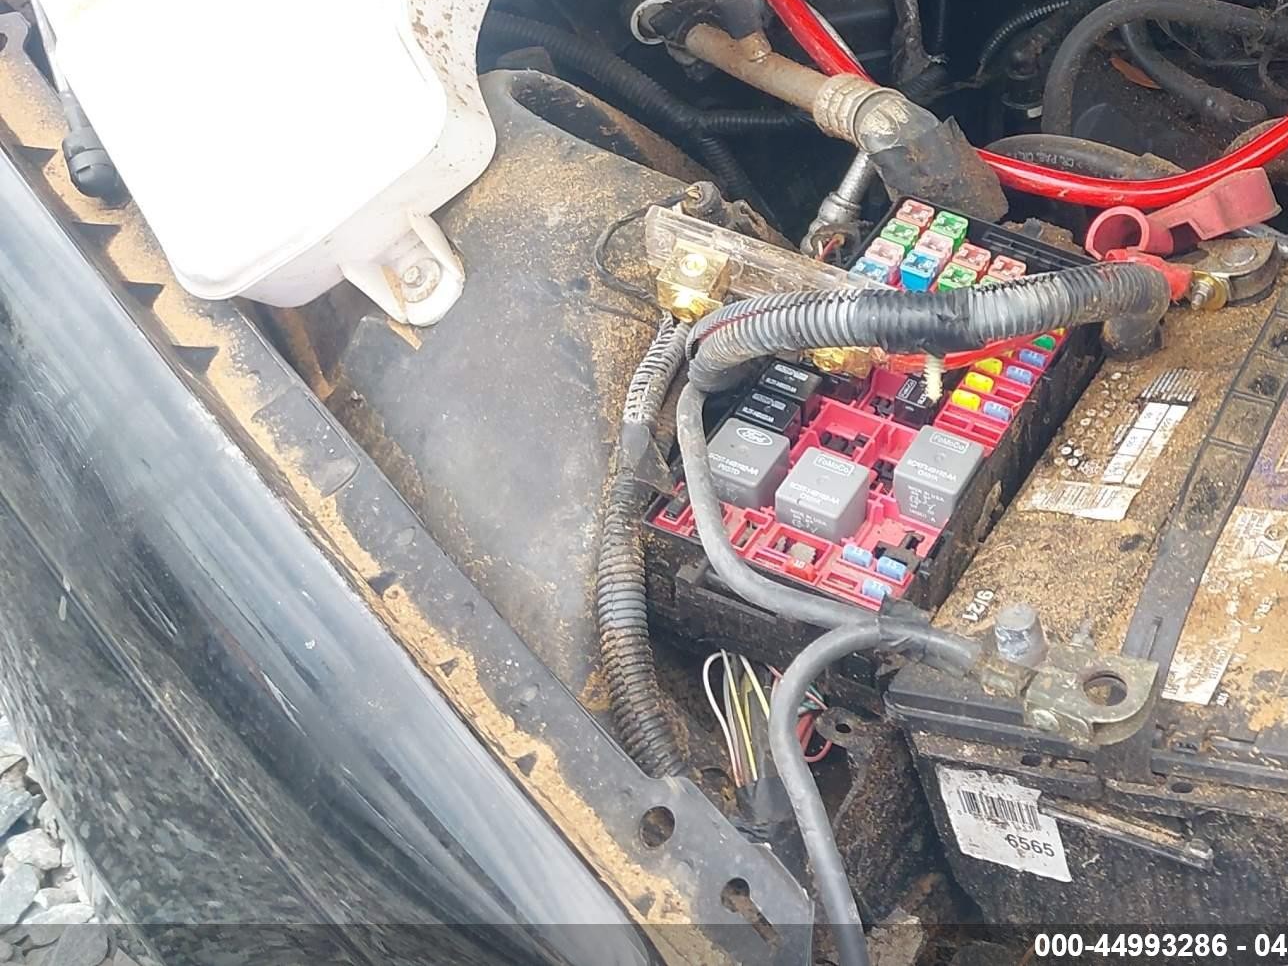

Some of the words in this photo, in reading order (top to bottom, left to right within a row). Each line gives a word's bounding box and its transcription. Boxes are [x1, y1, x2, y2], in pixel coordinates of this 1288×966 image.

[933, 434, 965, 451] FoMoCo
[816, 456, 849, 474] FoMoCo
[1007, 834, 1056, 858] 6565
